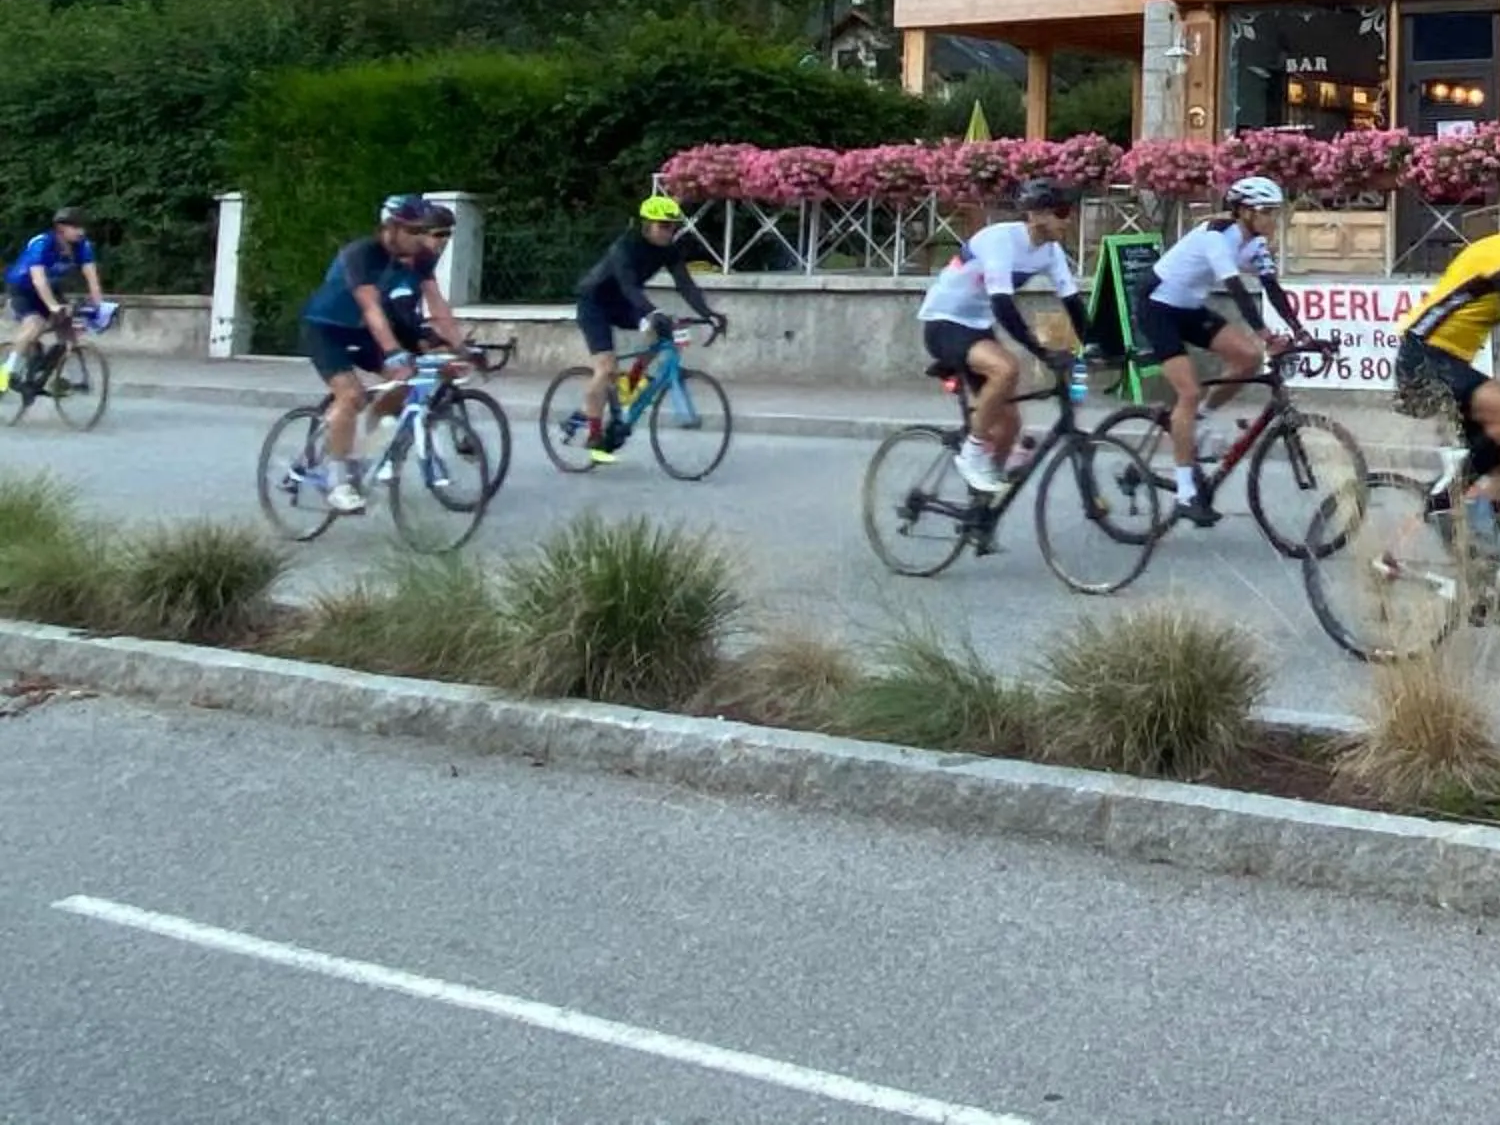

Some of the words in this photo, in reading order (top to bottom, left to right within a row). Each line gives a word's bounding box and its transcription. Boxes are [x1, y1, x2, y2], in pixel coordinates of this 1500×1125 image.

[1286, 56, 1328, 73] BAR
[1281, 290, 1429, 322] OBERLA
[1331, 328, 1363, 347] Bar
[1360, 357, 1391, 381] 80
